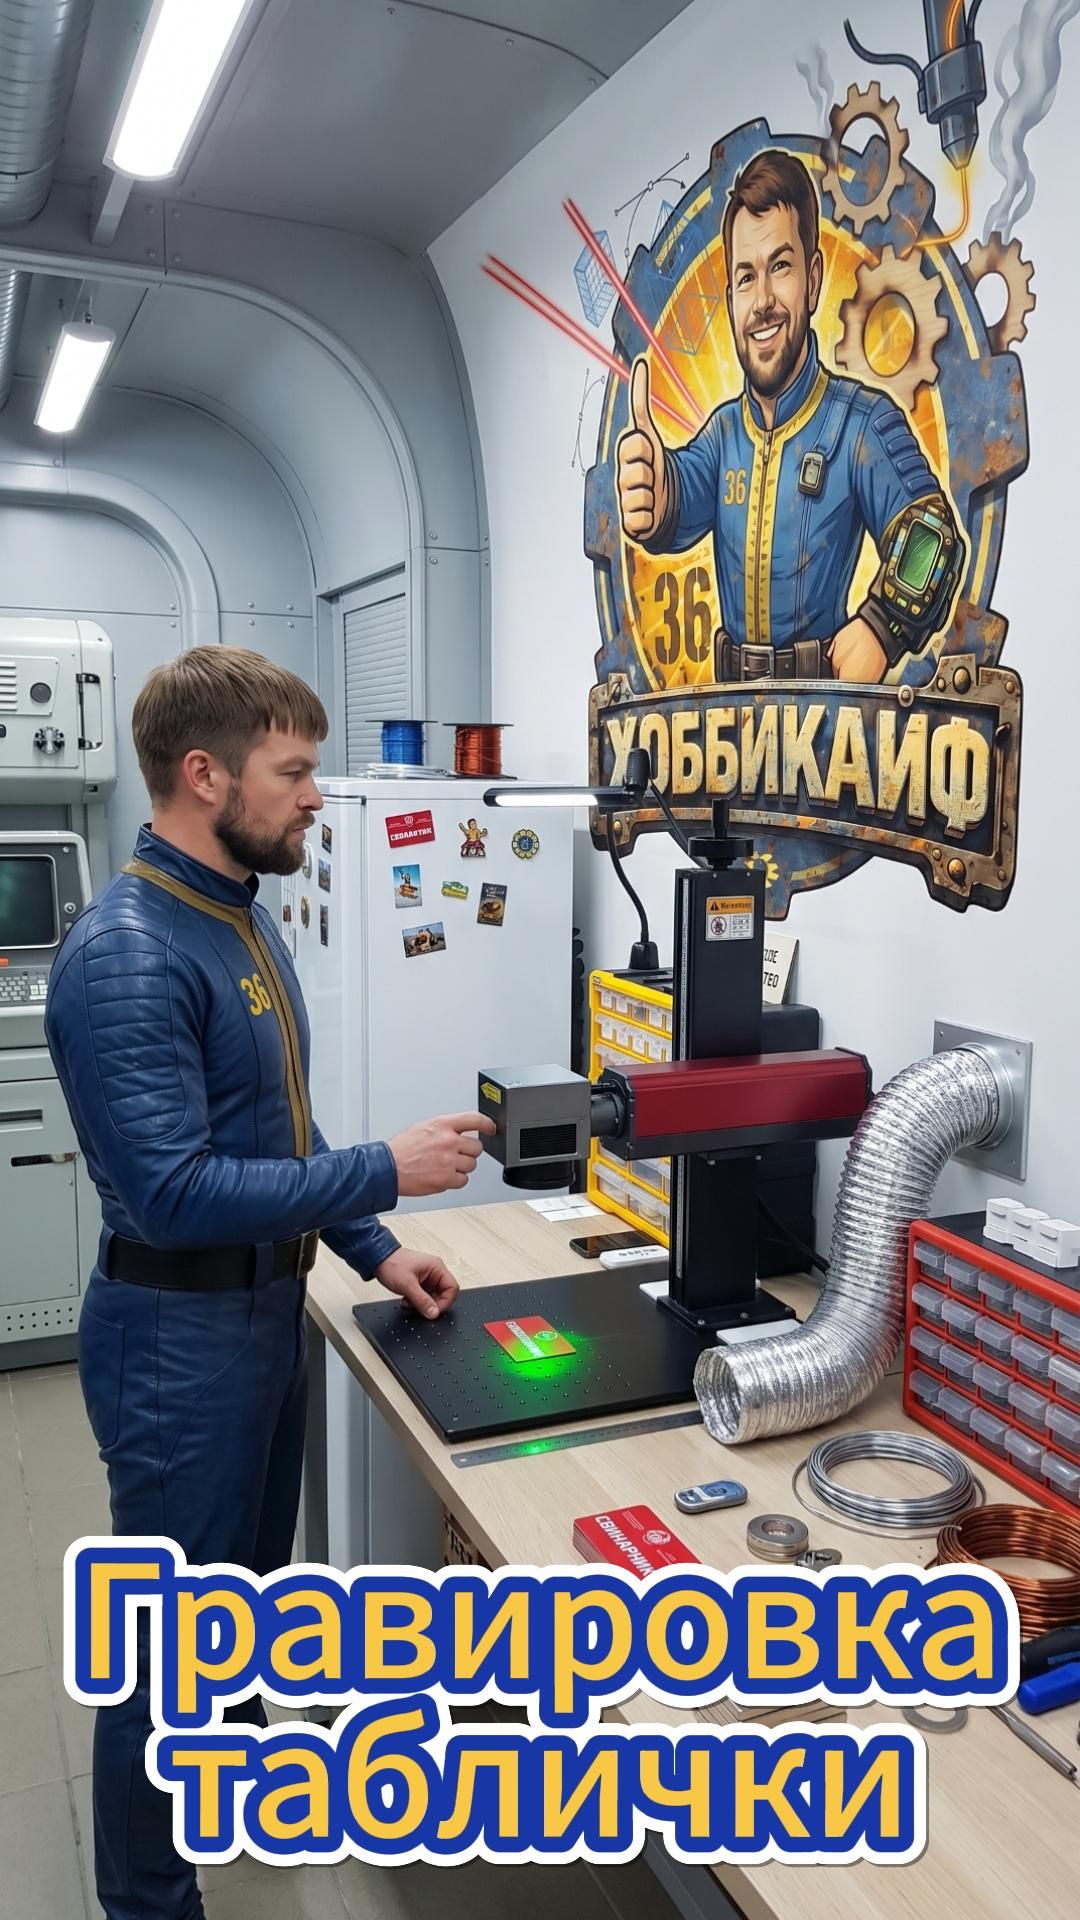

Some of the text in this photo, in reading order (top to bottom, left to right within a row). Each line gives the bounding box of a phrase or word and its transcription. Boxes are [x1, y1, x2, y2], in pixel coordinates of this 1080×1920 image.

[723, 468, 747, 506] 36
[654, 566, 712, 665] 36
[240, 972, 271, 1016] 36
[594, 1514, 657, 1577] СВИНАРНИК
